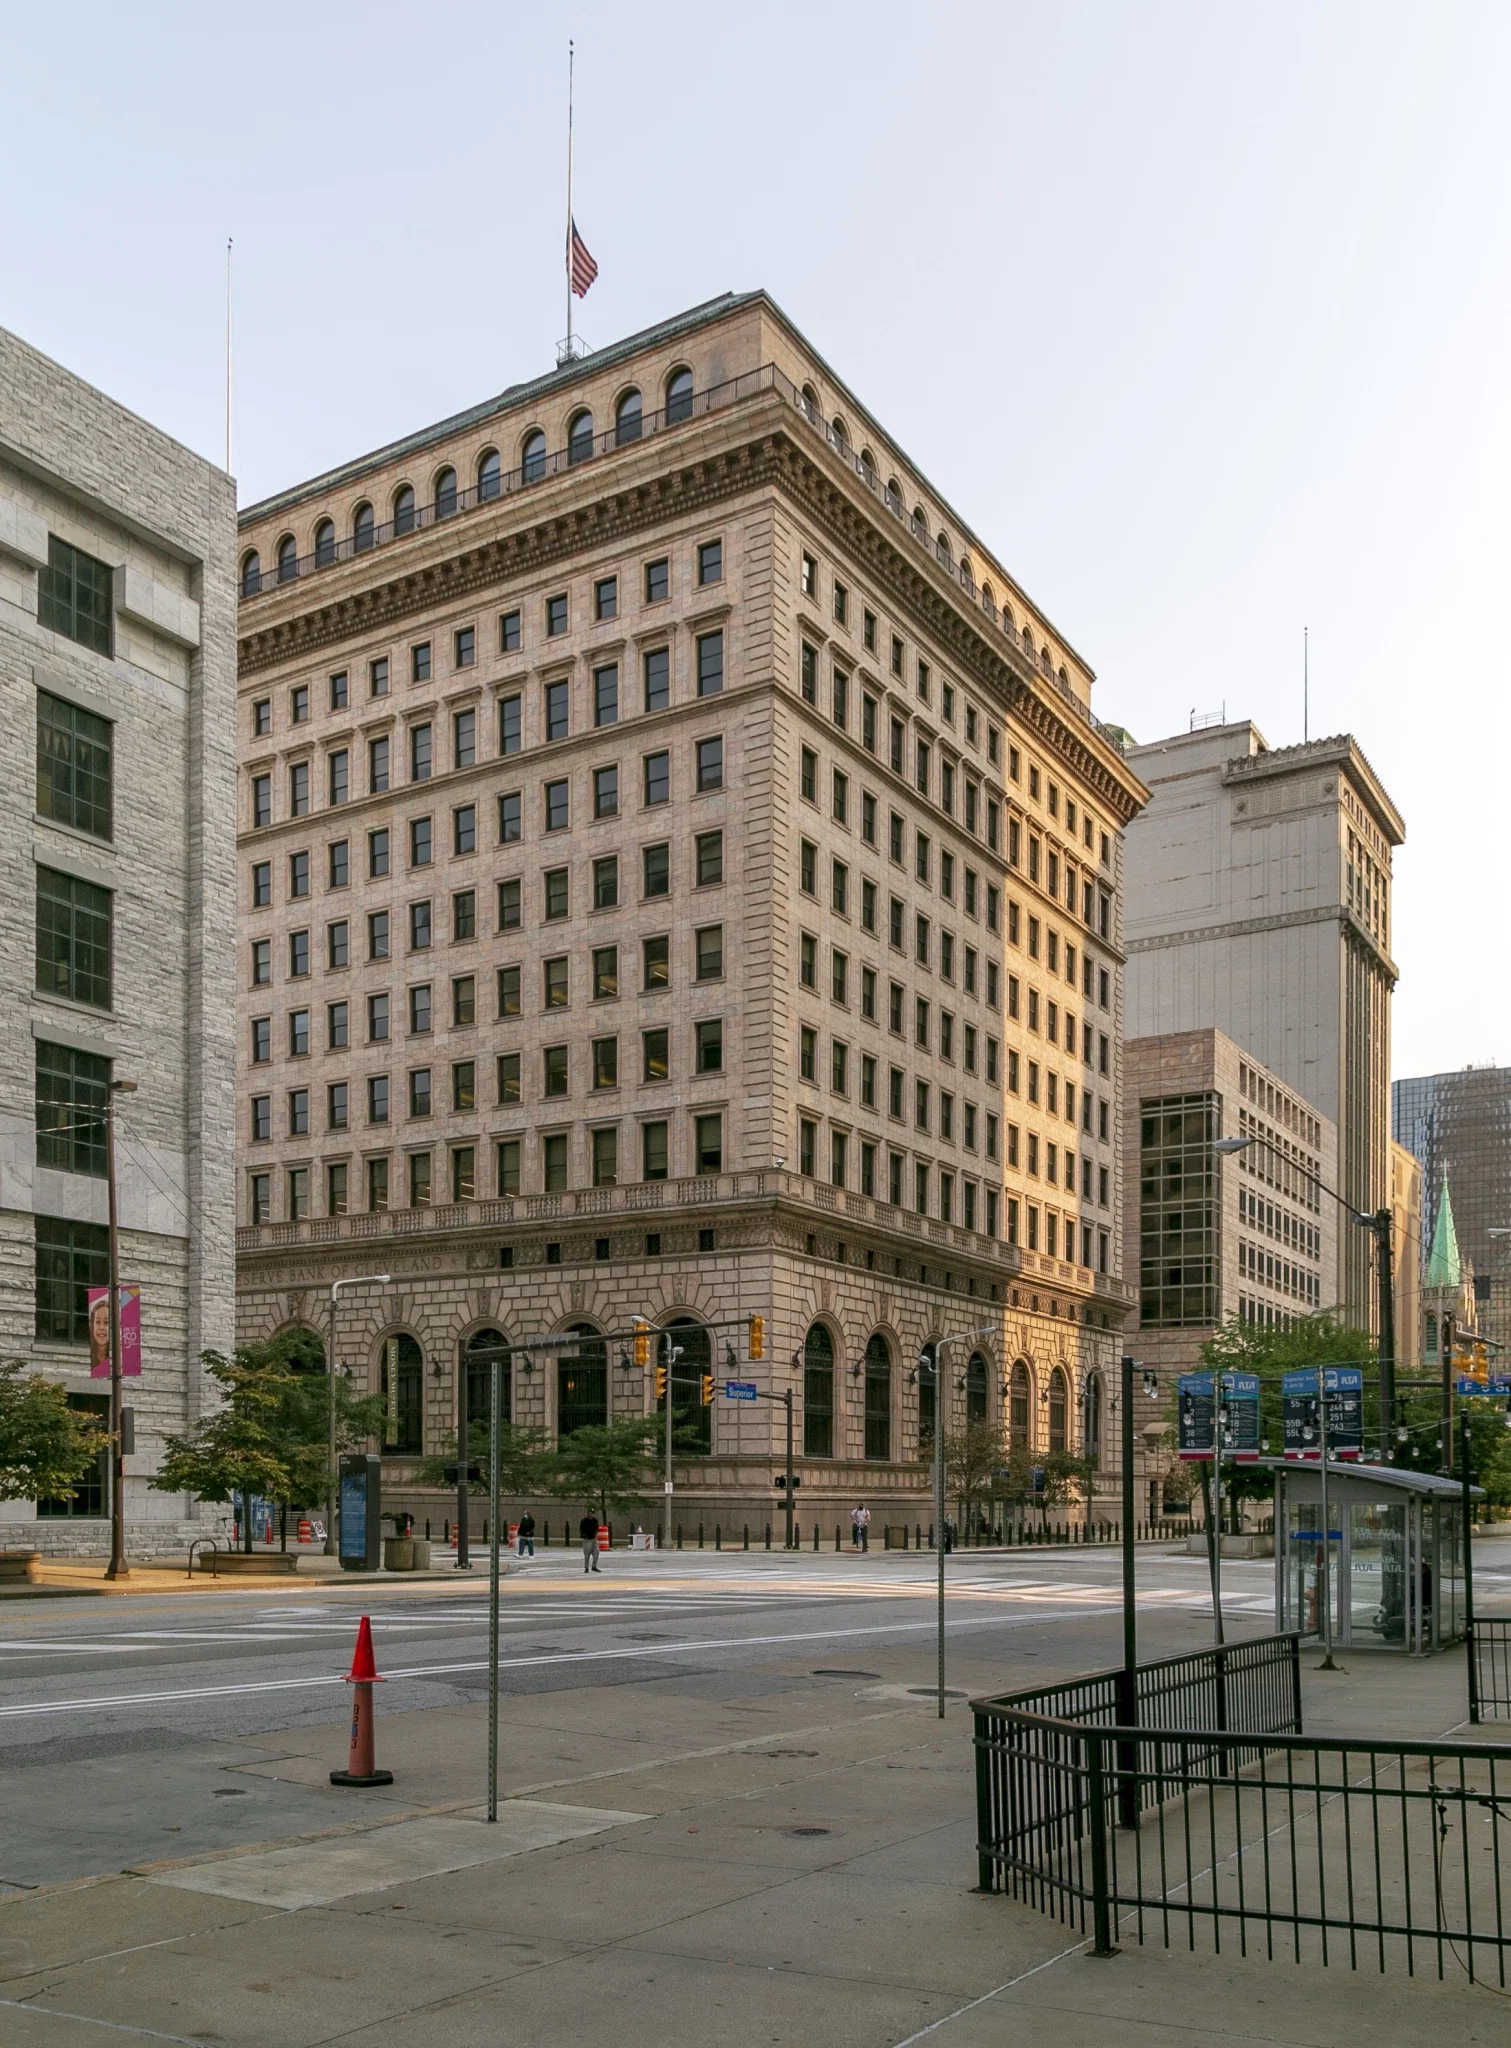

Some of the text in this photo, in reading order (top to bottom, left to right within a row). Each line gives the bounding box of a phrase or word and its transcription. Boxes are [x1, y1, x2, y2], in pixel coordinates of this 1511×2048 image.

[290, 1266, 325, 1282] BANK
[331, 1265, 349, 1279] OF
[355, 1256, 443, 1276] CLEVELAND
[1283, 1375, 1305, 1383] Superior
[1341, 1376, 1358, 1385] RTA
[1238, 1381, 1255, 1390] RTA
[728, 1387, 754, 1399] Superior
[1290, 1400, 1300, 1408] 55
[1329, 1413, 1343, 1421] 251
[1285, 1419, 1301, 1427] 55B
[1330, 1423, 1344, 1431] 263
